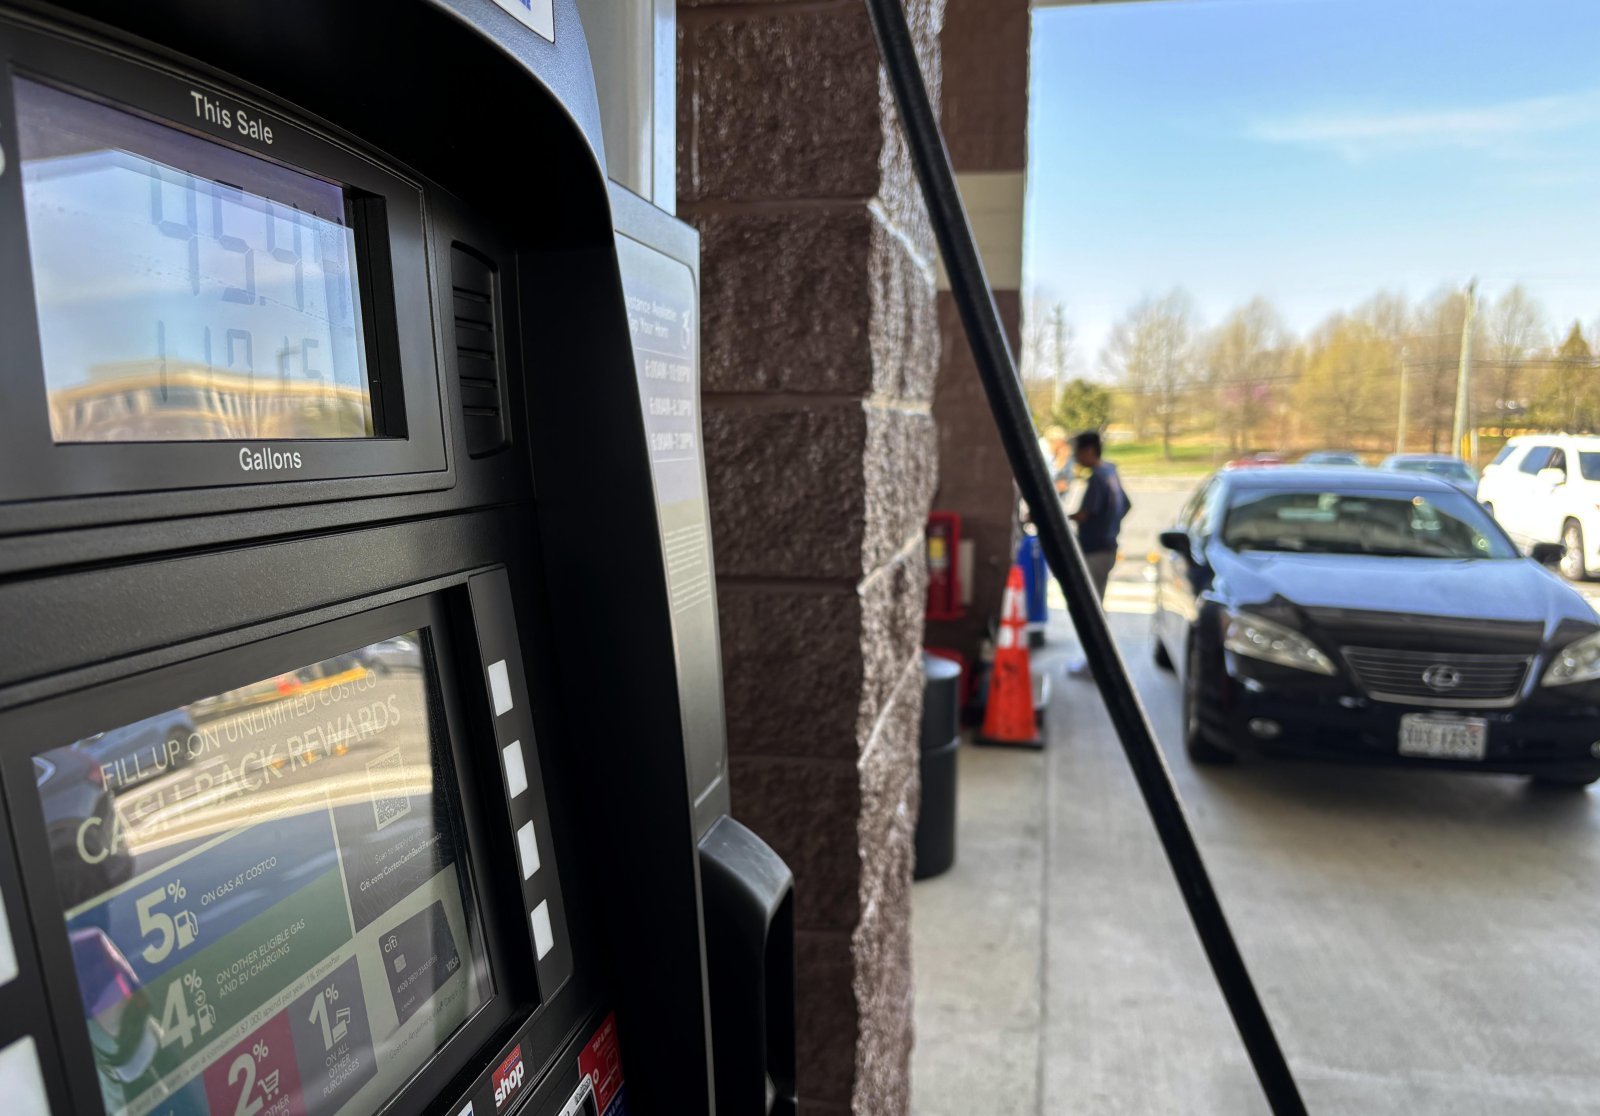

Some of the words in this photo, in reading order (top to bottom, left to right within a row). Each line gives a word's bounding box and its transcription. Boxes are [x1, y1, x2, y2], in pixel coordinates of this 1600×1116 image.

[191, 91, 231, 128] This
[237, 110, 274, 144] Sale
[239, 447, 303, 471] Gallons
[100, 752, 150, 791] FILL
[151, 740, 181, 771] UP
[187, 727, 220, 757] ON
[223, 691, 316, 743] UNLIMITED
[319, 668, 377, 706] COSTCO
[287, 694, 400, 772] REWARDS
[135, 879, 187, 964] 5%
[201, 891, 216, 906] ON
[216, 882, 234, 899] GAS
[235, 874, 245, 887] AT
[246, 856, 277, 880] COSTCO
[160, 969, 203, 1049] 4%
[216, 968, 231, 985] ON
[231, 949, 258, 975] OTHER
[259, 928, 290, 955] ELIGIBLE
[290, 918, 305, 934] GAS
[220, 979, 238, 998] AND
[239, 971, 249, 985] EV
[250, 943, 290, 976] CHARGING
[308, 984, 340, 1051] 1%
[228, 1039, 269, 1116] 2%
[323, 1060, 361, 1097] PURCHASES
[326, 1051, 338, 1067] ON
[338, 1043, 350, 1059] ALL
[328, 1055, 351, 1079] OTHER
[495, 1060, 525, 1107] shop
